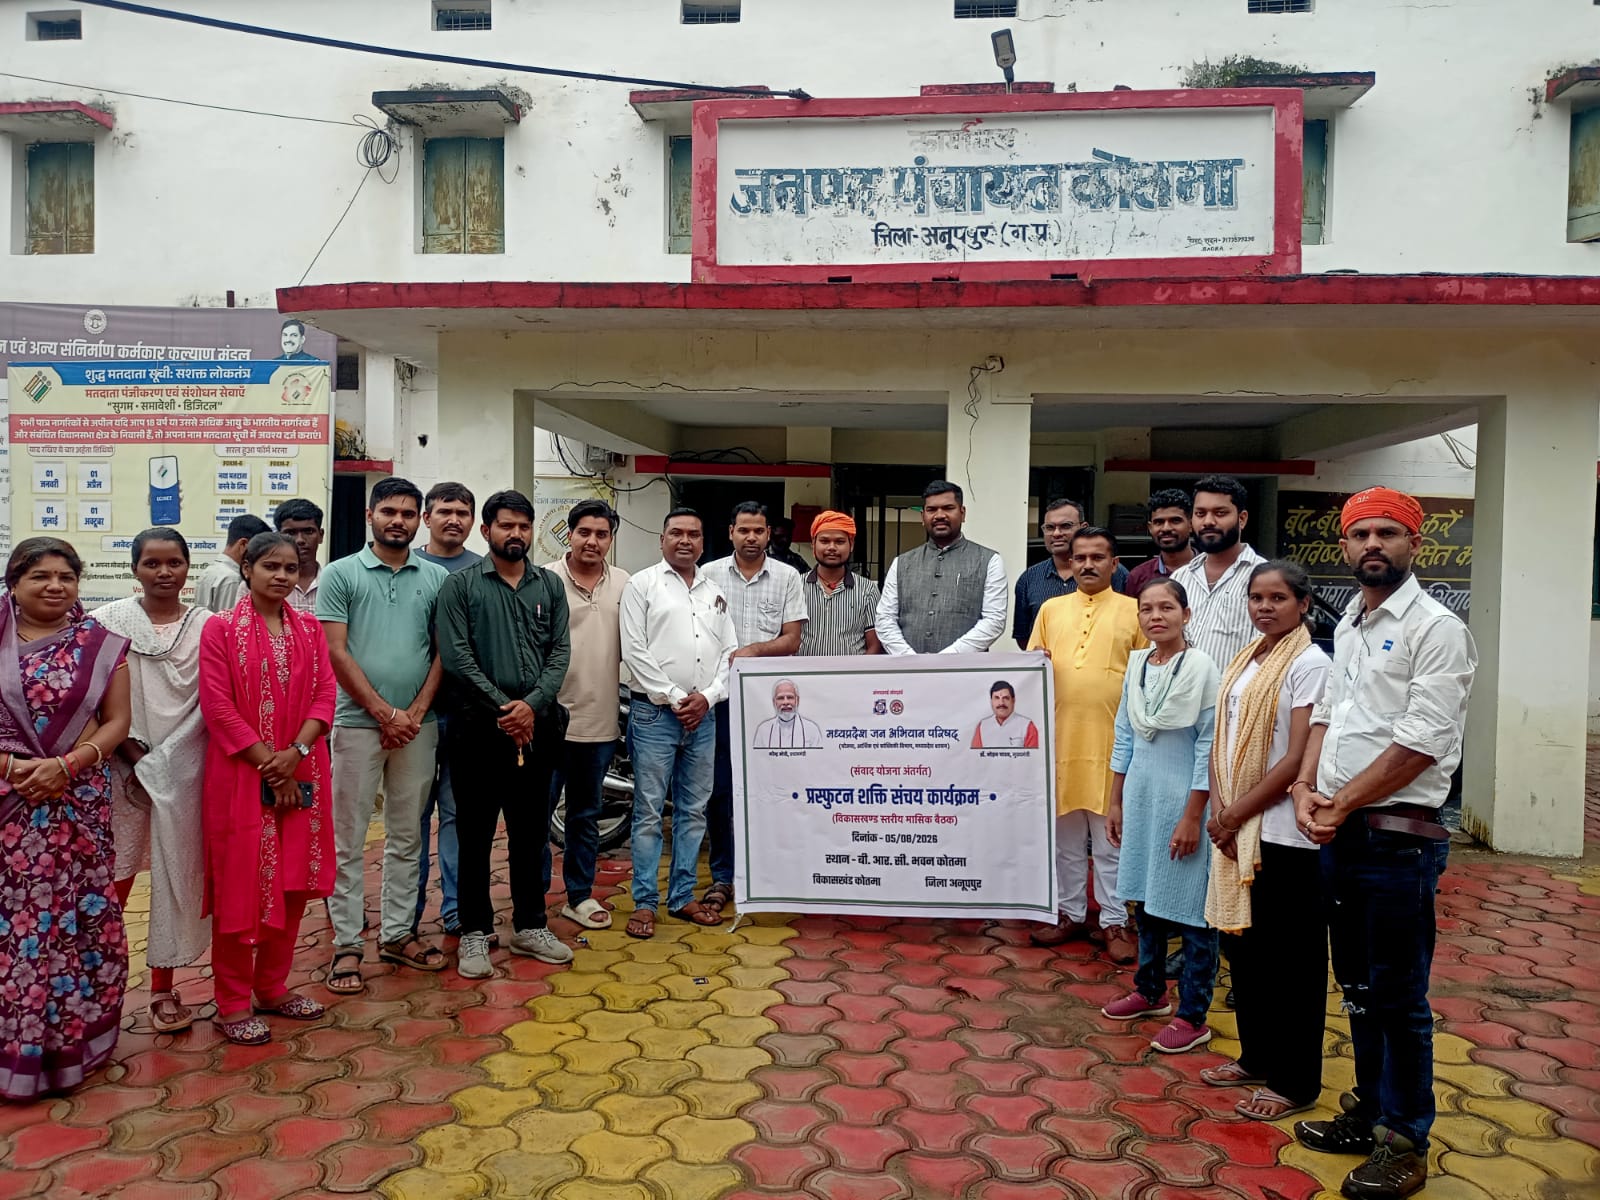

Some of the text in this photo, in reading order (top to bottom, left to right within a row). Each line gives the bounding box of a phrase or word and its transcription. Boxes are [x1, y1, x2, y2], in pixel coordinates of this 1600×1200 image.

[10, 337, 28, 354] एवं
[30, 341, 58, 356] अन्य
[61, 338, 115, 358] संनिर्माण
[117, 341, 165, 360] कर्मकार
[168, 345, 217, 360] कल्याण
[85, 369, 106, 382] शुद्ध
[108, 370, 146, 379] मतदाता
[175, 369, 208, 379] सशक्त
[210, 367, 251, 378] लोकतंत्र
[85, 389, 119, 398] मतदाता
[121, 386, 163, 398] पंजीकरण
[165, 386, 180, 397] एवं
[181, 385, 217, 397] संशोधन
[140, 399, 176, 410] समावेशी
[130, 418, 145, 426] आप
[253, 417, 280, 427] भारतीय
[90, 470, 98, 478] 01
[40, 478, 59, 488] जनवरी
[826, 726, 867, 740] मध्यप्रदेश
[870, 729, 886, 739] जन
[889, 725, 925, 739] अभियान
[850, 764, 931, 777] (संवाद योजना अंतर्गत)
[805, 783, 980, 809] प्रस्फुटन शक्ति संचय कार्यक्रम
[881, 814, 903, 825] स्तरीय
[905, 814, 933, 825] मासिक
[934, 813, 958, 826] बैठक)
[851, 831, 878, 843] दिनांक
[825, 853, 850, 865] स्थान
[911, 856, 934, 867] भवन
[936, 854, 967, 867] कोतमा
[813, 873, 881, 886] विकासखंड कोतमा
[925, 876, 982, 891] जिला अनूपपुर
